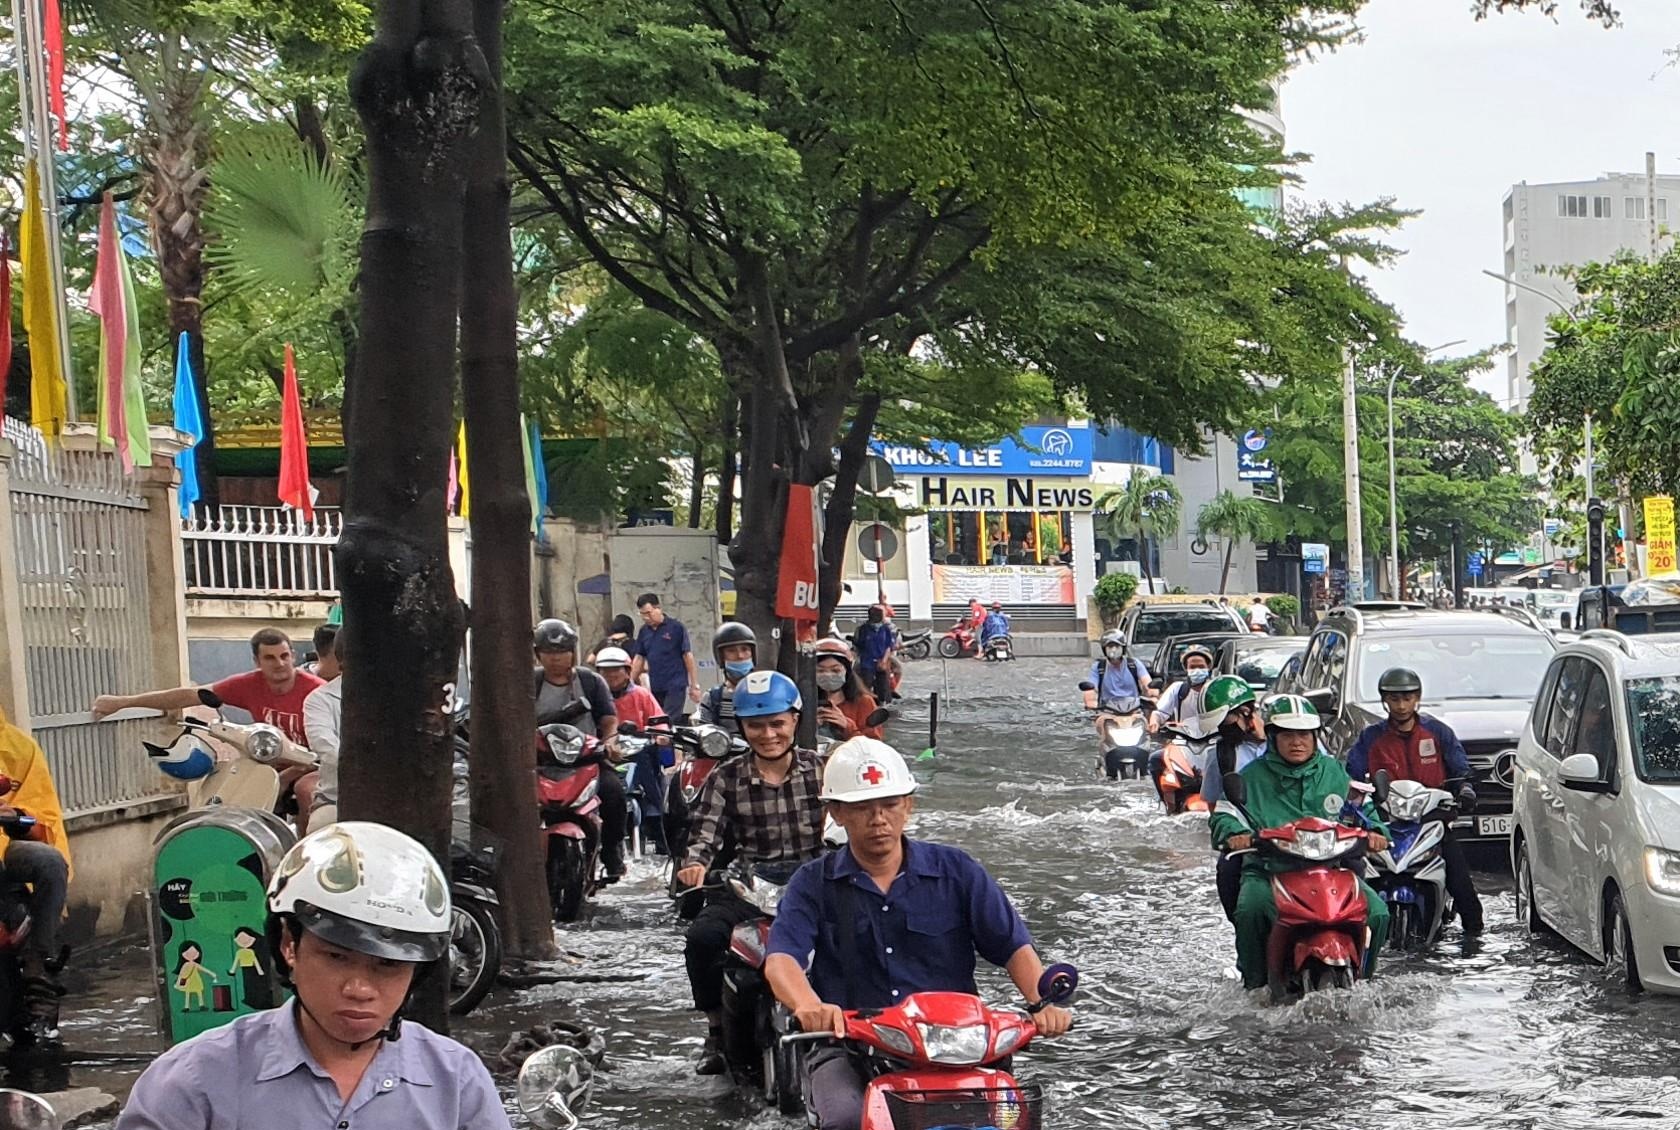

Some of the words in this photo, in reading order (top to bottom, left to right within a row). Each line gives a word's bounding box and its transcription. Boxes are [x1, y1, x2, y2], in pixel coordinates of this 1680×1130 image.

[959, 449, 1003, 467] LEE
[922, 477, 995, 507] HAIR
[1007, 478, 1094, 508] NEWS
